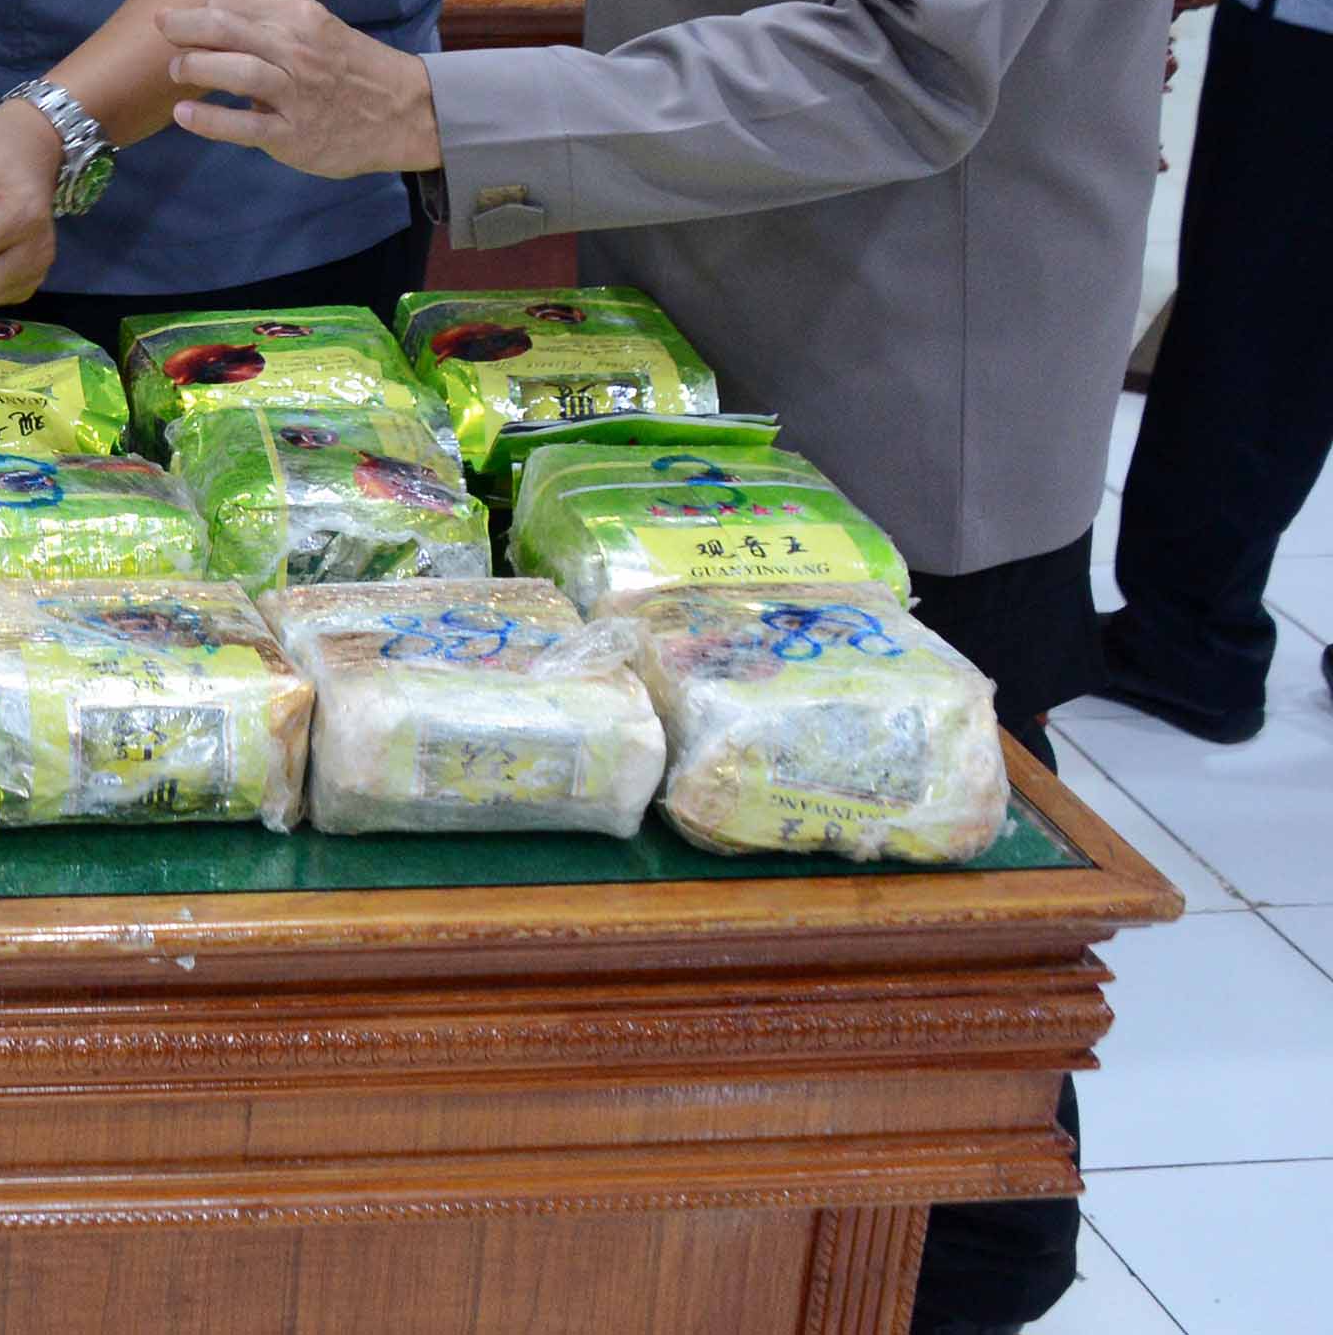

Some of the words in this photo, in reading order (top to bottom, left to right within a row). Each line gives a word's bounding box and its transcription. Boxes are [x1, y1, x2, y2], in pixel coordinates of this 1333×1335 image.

[695, 535, 809, 559] 观音王
[690, 562, 831, 578] GUANYINWANG
